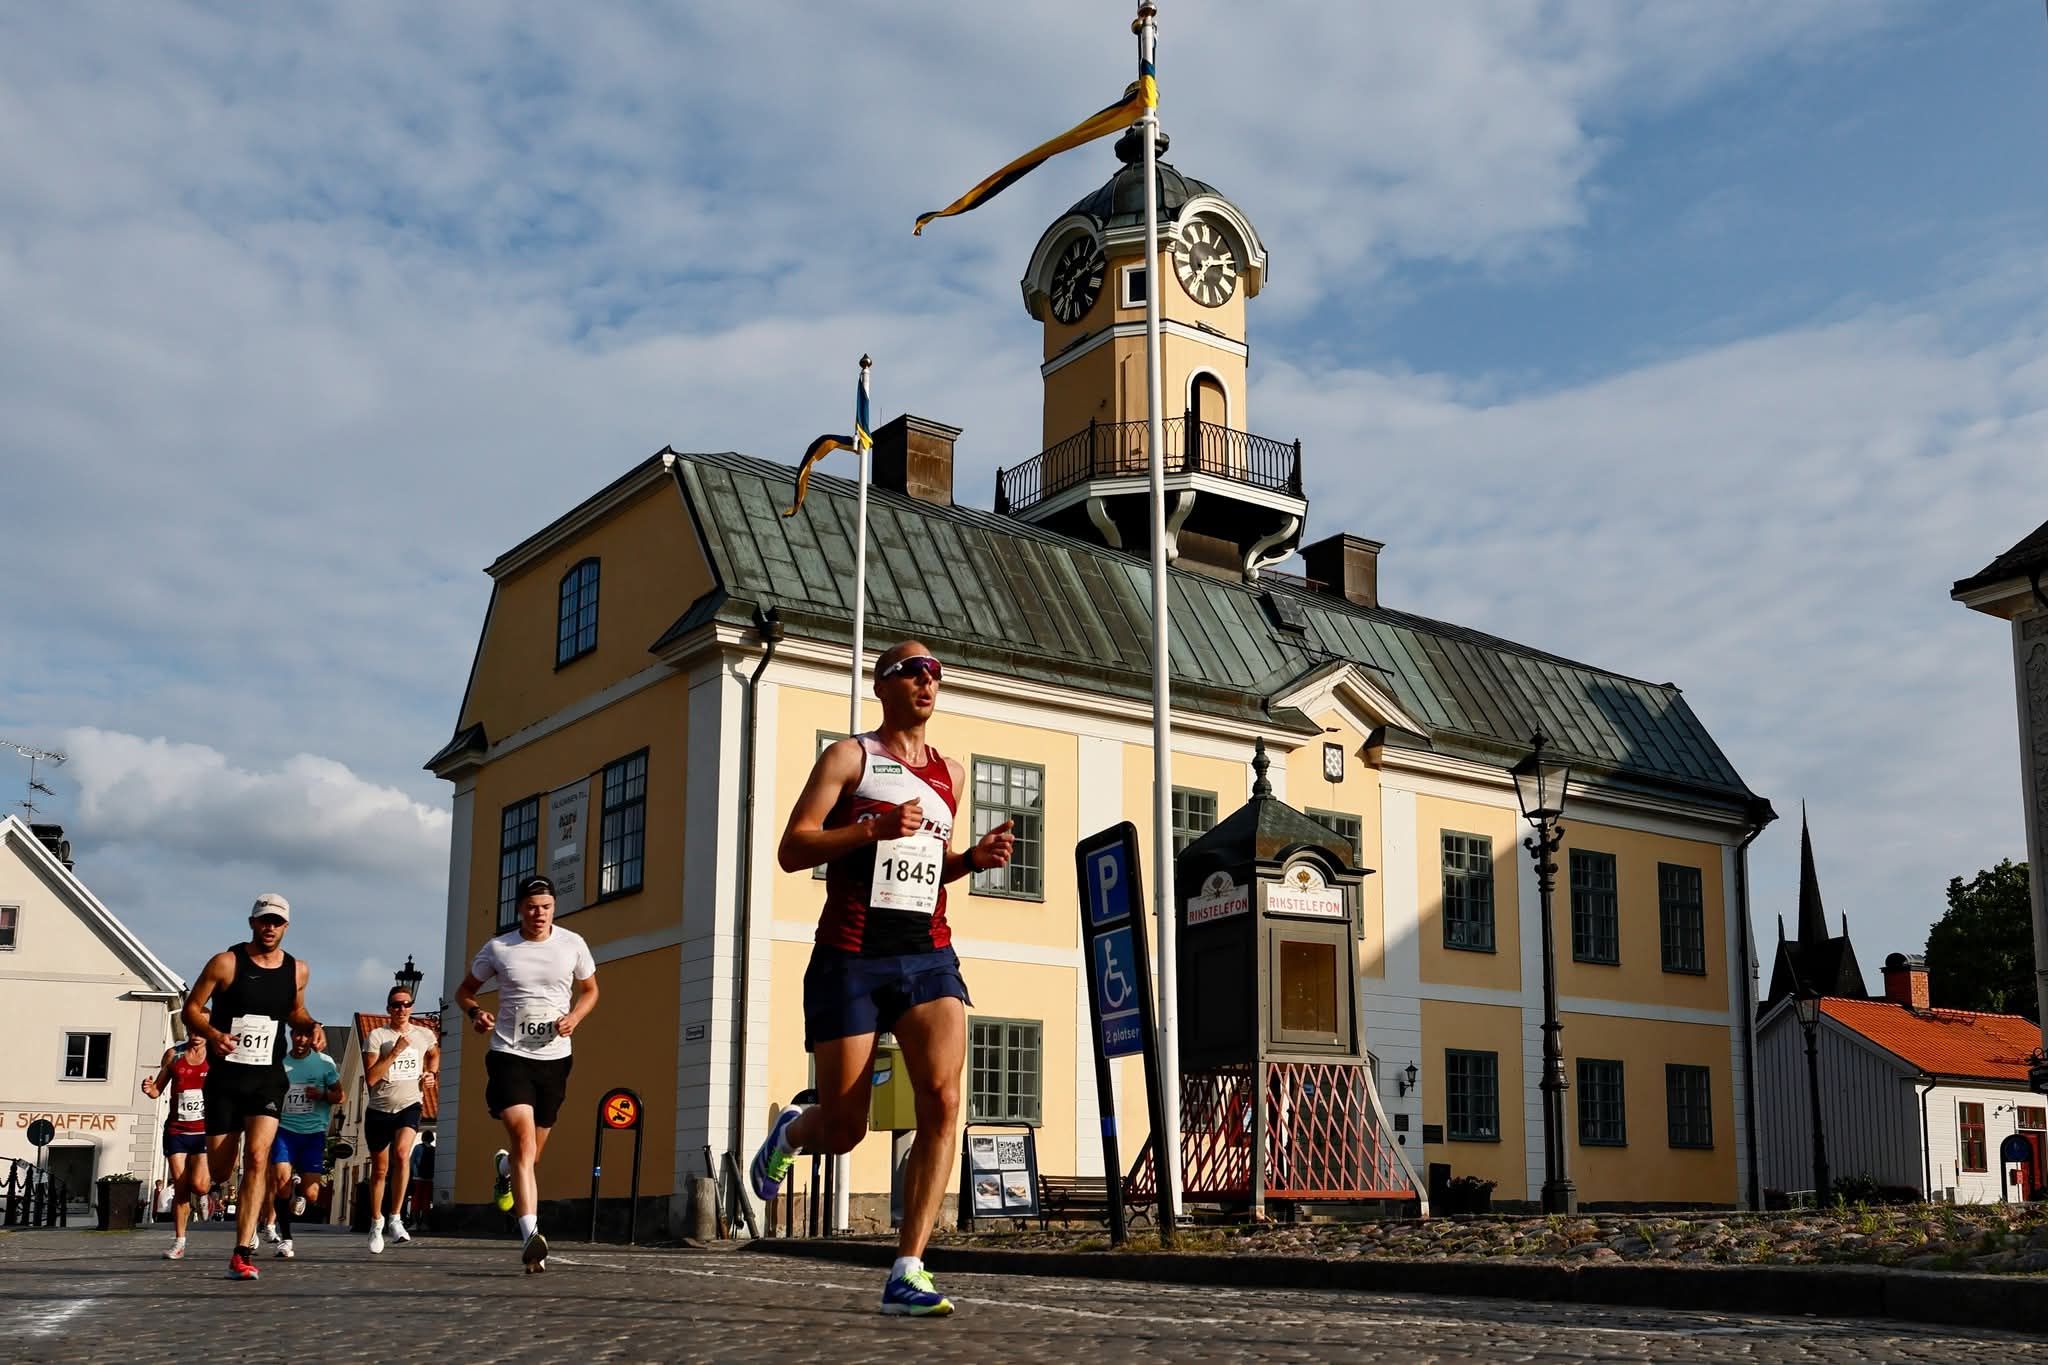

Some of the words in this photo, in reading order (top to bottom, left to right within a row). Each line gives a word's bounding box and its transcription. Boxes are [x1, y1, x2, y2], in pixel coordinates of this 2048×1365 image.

[882, 858, 937, 886] 1845
[1098, 854, 1118, 914] P
[1189, 898, 1249, 923] RIKSTELEFON
[1268, 896, 1340, 914] RIKSTELEFON
[518, 1021, 553, 1036] 1661
[1105, 1031, 1111, 1044] 2
[1112, 1028, 1139, 1047] platser
[233, 1032, 270, 1050] 1611
[392, 1059, 417, 1071] 1735
[180, 1100, 205, 1112] 1627
[287, 1094, 310, 1104] 171
